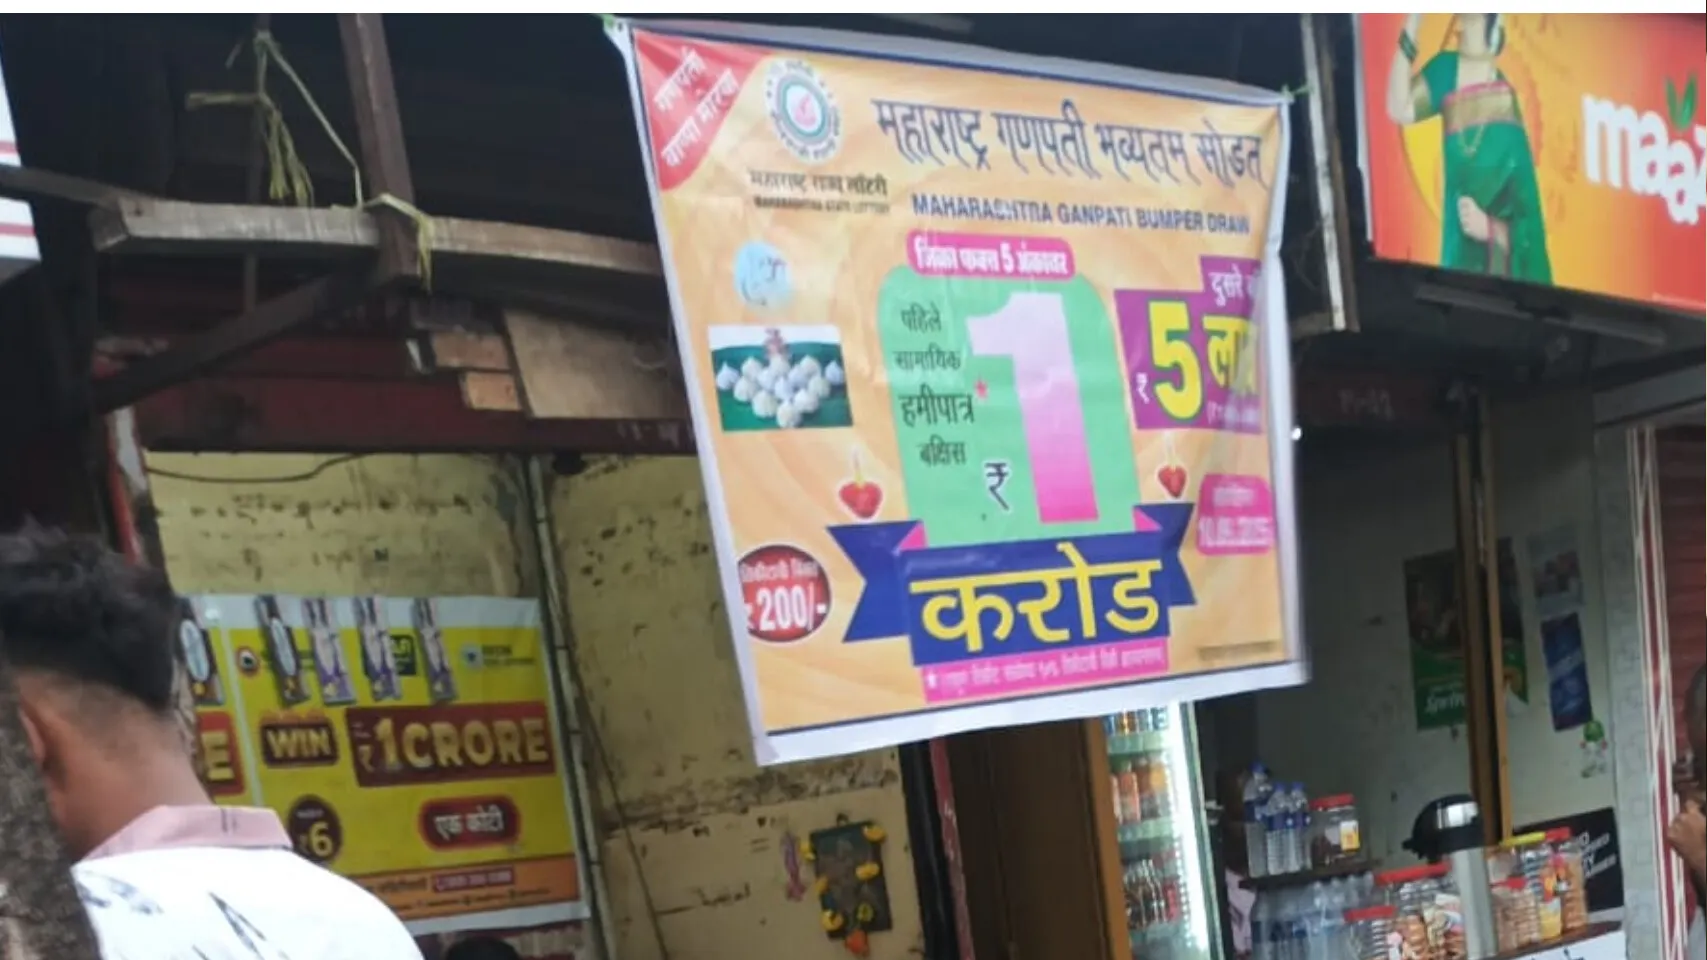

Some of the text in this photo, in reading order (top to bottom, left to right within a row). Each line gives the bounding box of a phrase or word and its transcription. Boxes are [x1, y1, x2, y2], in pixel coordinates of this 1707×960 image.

[870, 100, 991, 171] महाराष्ट्र
[992, 99, 1100, 179] गणपती
[1097, 123, 1200, 184] भव्यतम
[1191, 117, 1269, 190] सोडत
[1582, 94, 1706, 225] maa
[912, 193, 1251, 235] MAHARASHTRA GANPATI BUMPER DRAW
[1000, 241, 1015, 274] 5
[900, 302, 942, 333] पहिले
[1148, 300, 1203, 421] 5
[898, 383, 975, 428] हमीपात्र
[965, 291, 1100, 523] ₹ 1
[909, 541, 1163, 653] करोड
[266, 727, 332, 759] WIN
[402, 716, 550, 769] CRORE
[435, 804, 505, 841] एक कोटी
